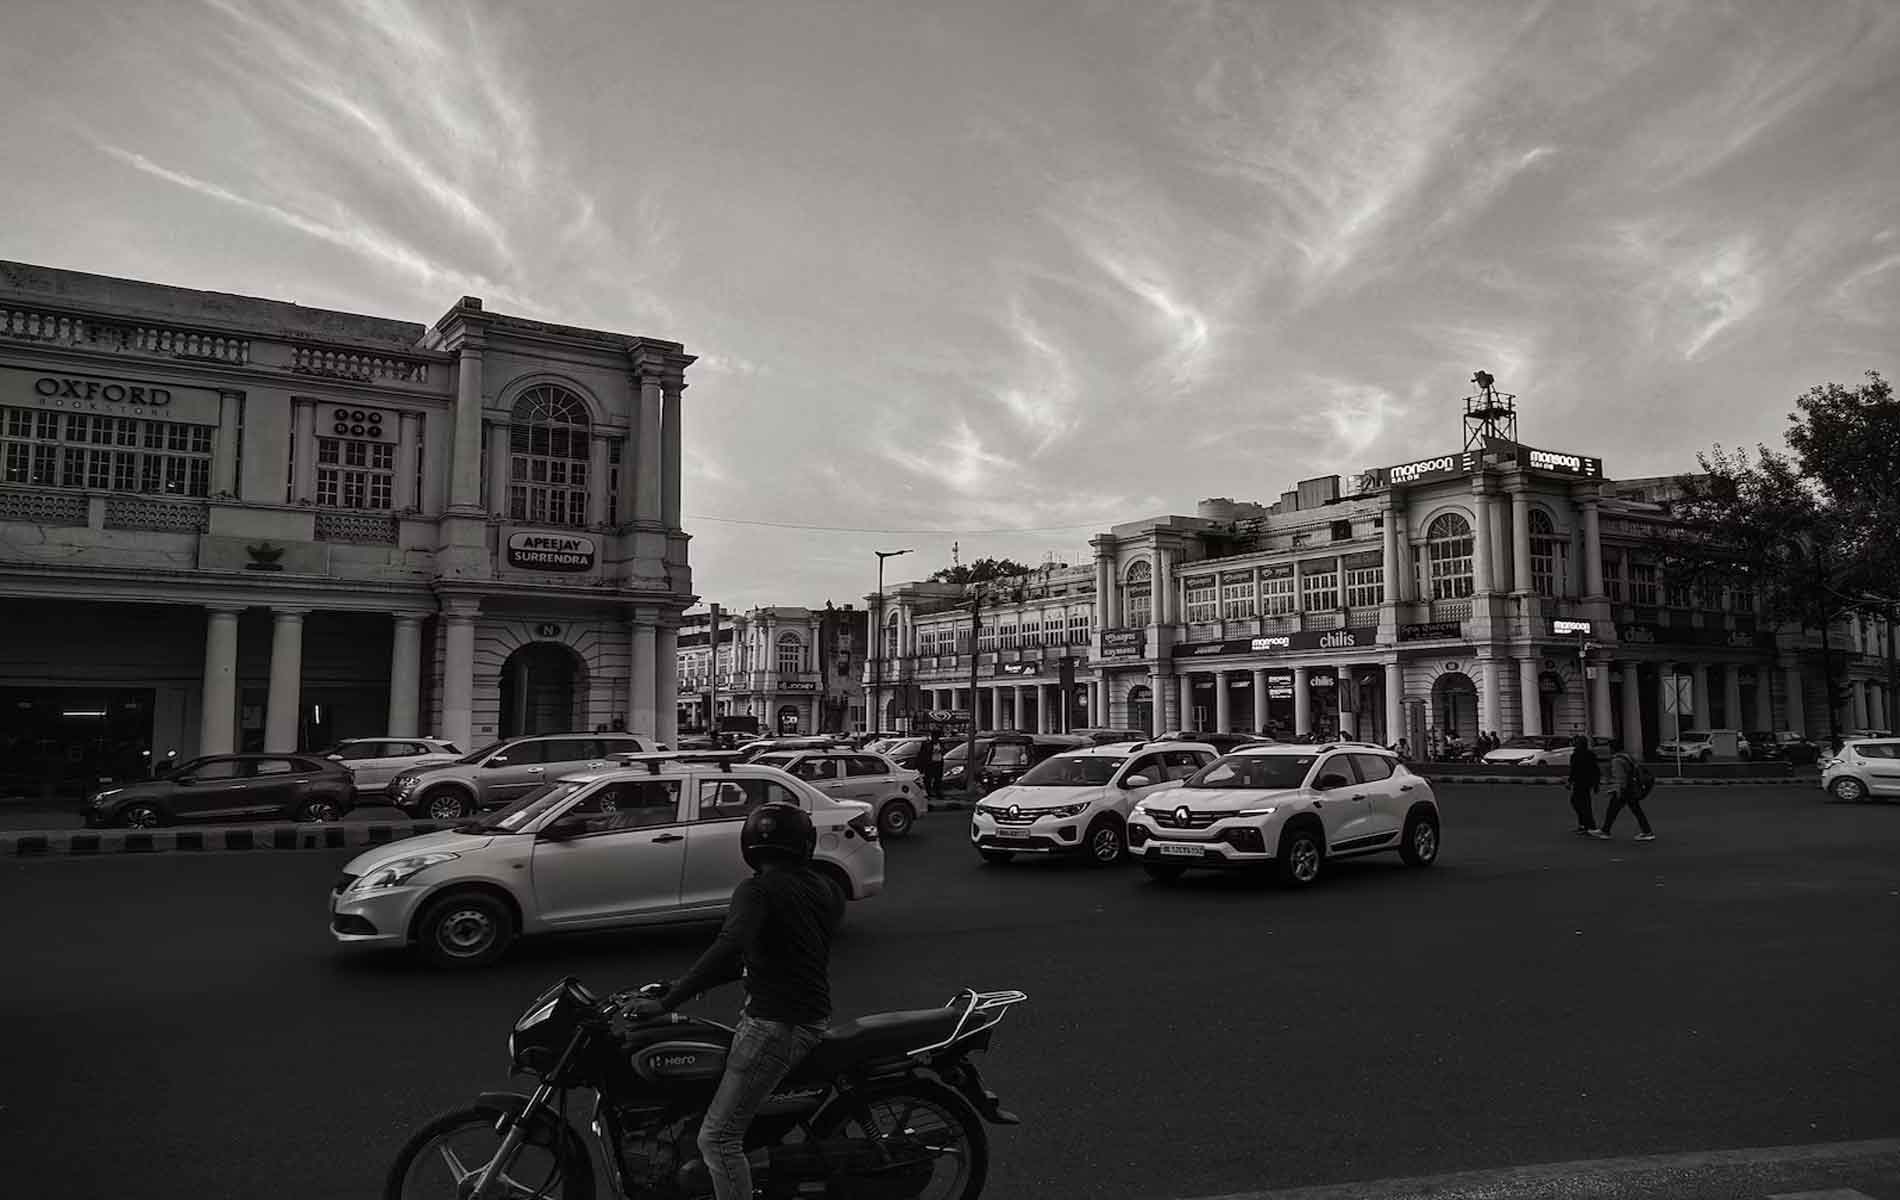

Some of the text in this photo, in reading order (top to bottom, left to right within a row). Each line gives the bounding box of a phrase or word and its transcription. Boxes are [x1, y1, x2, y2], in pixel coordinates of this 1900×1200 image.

[35, 378, 171, 406] OXFORD
[1391, 457, 1454, 478] monsoon
[1530, 451, 1581, 469] monsoon
[524, 537, 581, 551] APEEJAY
[514, 551, 588, 565] SURRENDRA
[1319, 631, 1355, 648] chilis
